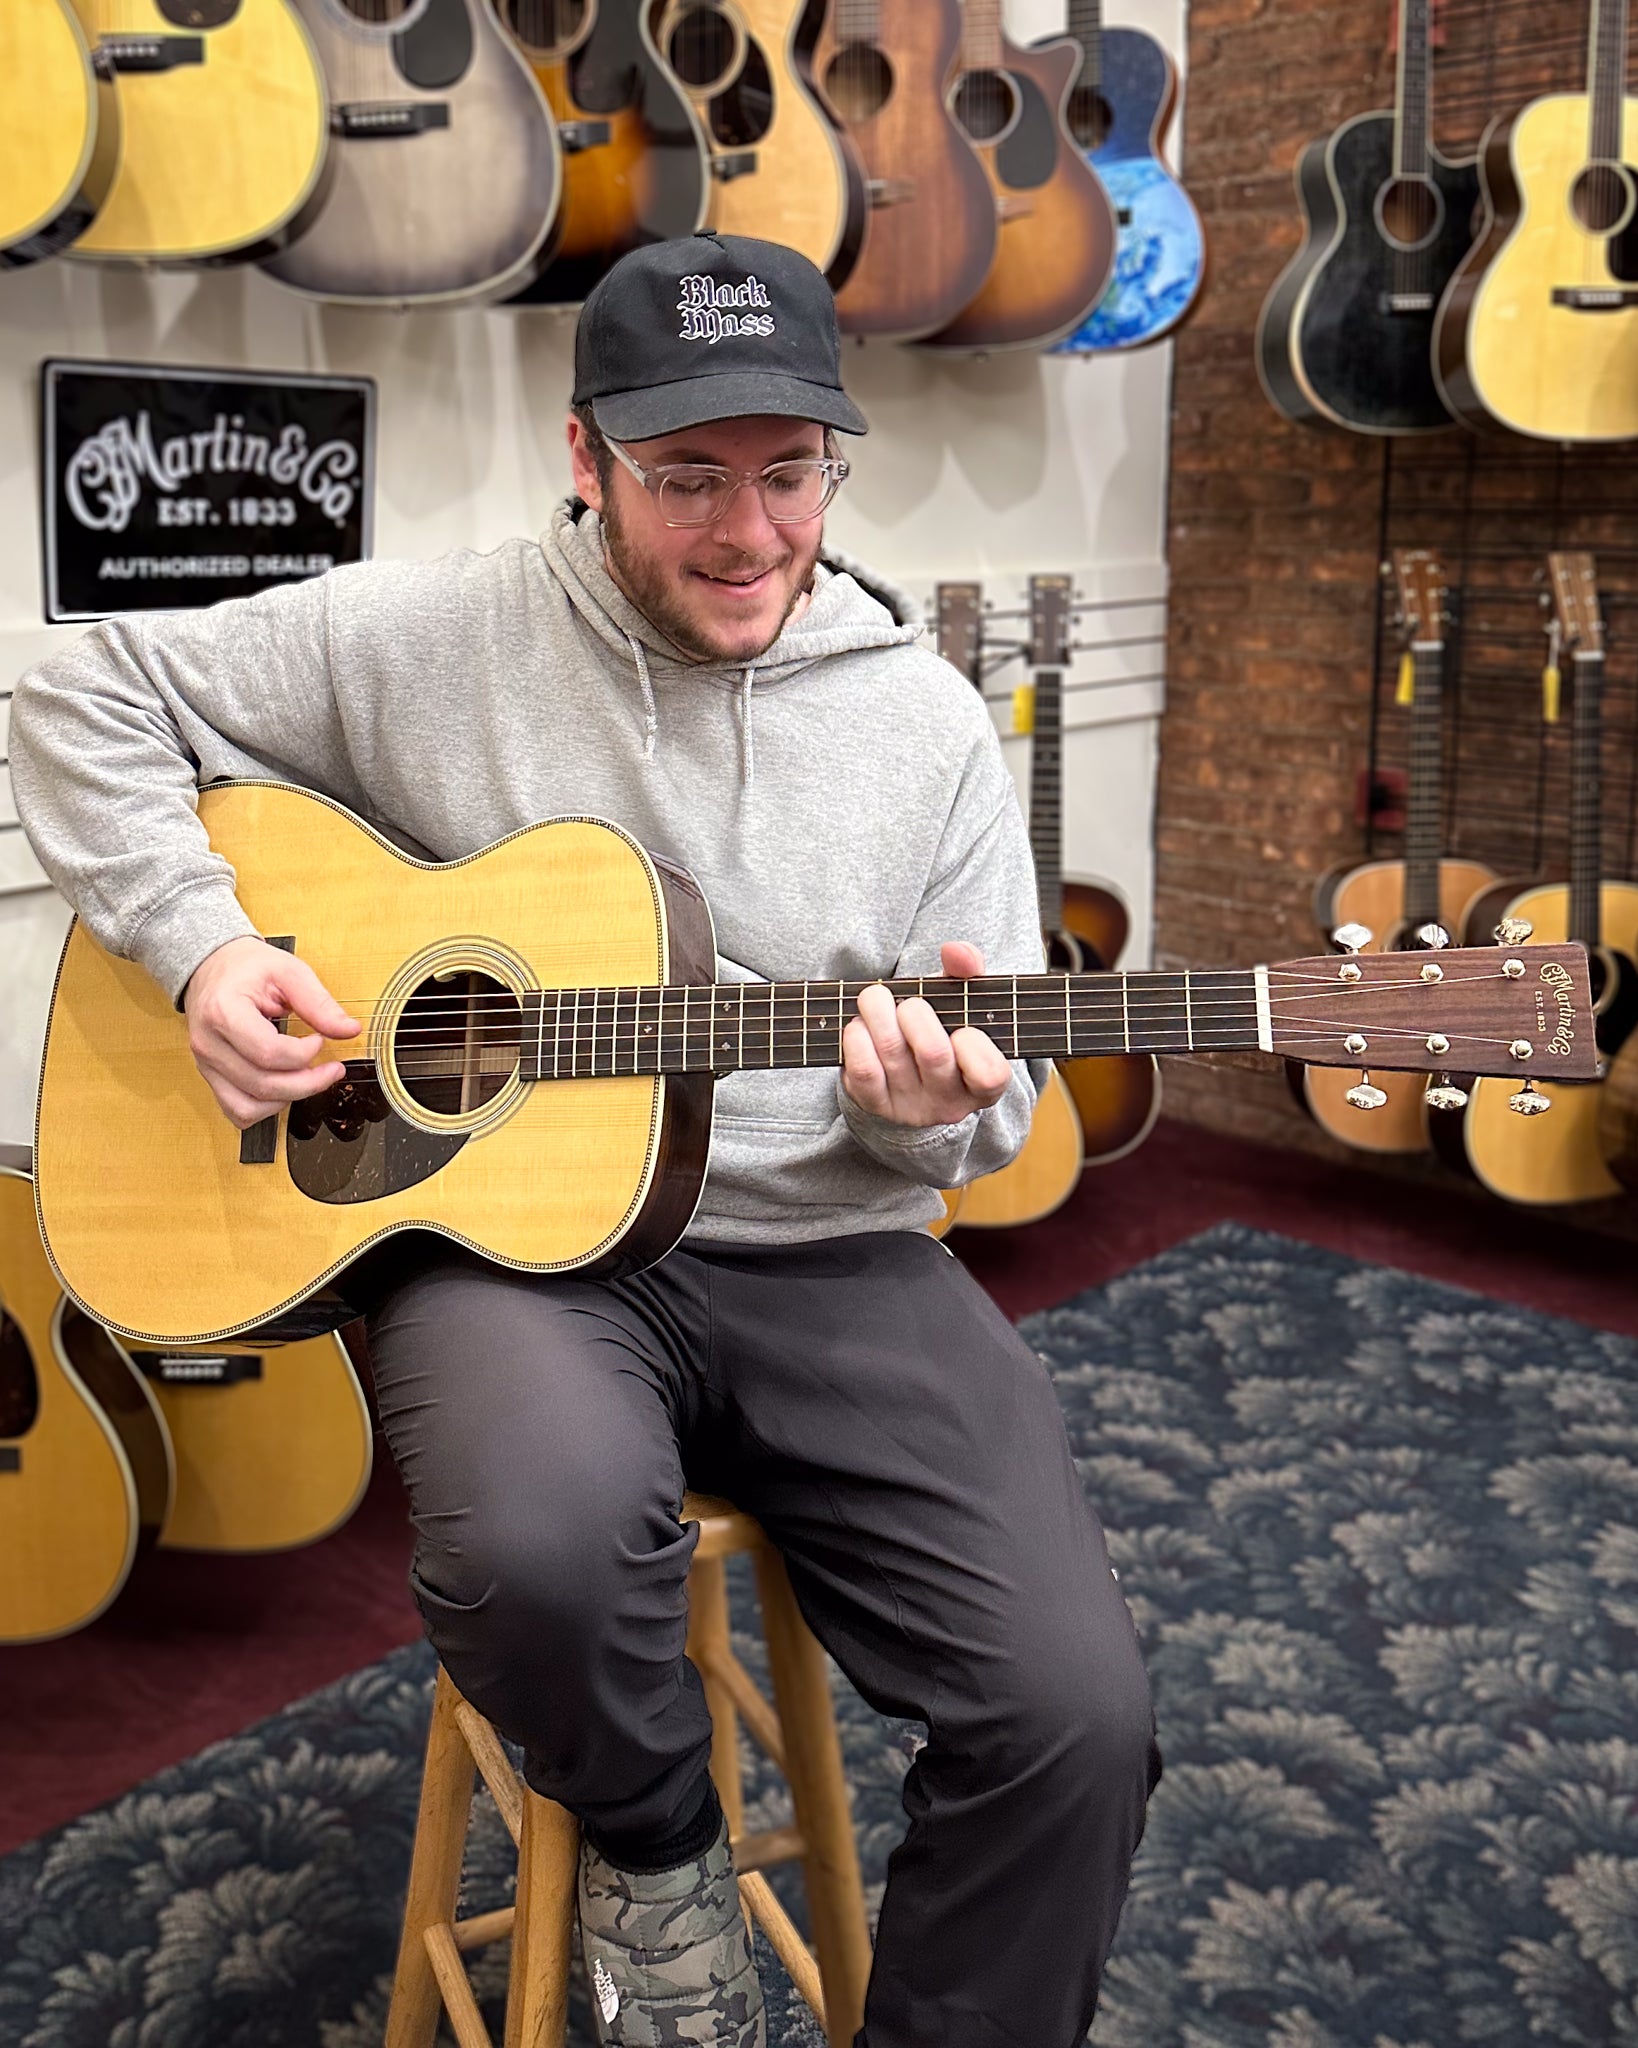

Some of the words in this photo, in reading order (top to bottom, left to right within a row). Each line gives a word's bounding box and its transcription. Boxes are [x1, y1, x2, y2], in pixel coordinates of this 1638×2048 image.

[676, 275, 771, 310] Black
[678, 308, 775, 344] Mass
[156, 497, 221, 526] EST.
[227, 497, 297, 526] 1833
[99, 556, 250, 579] AUTHORIZED
[253, 554, 334, 577] DEALER
[1534, 990, 1544, 1010] EST.
[1537, 1011, 1547, 1032] 1833
